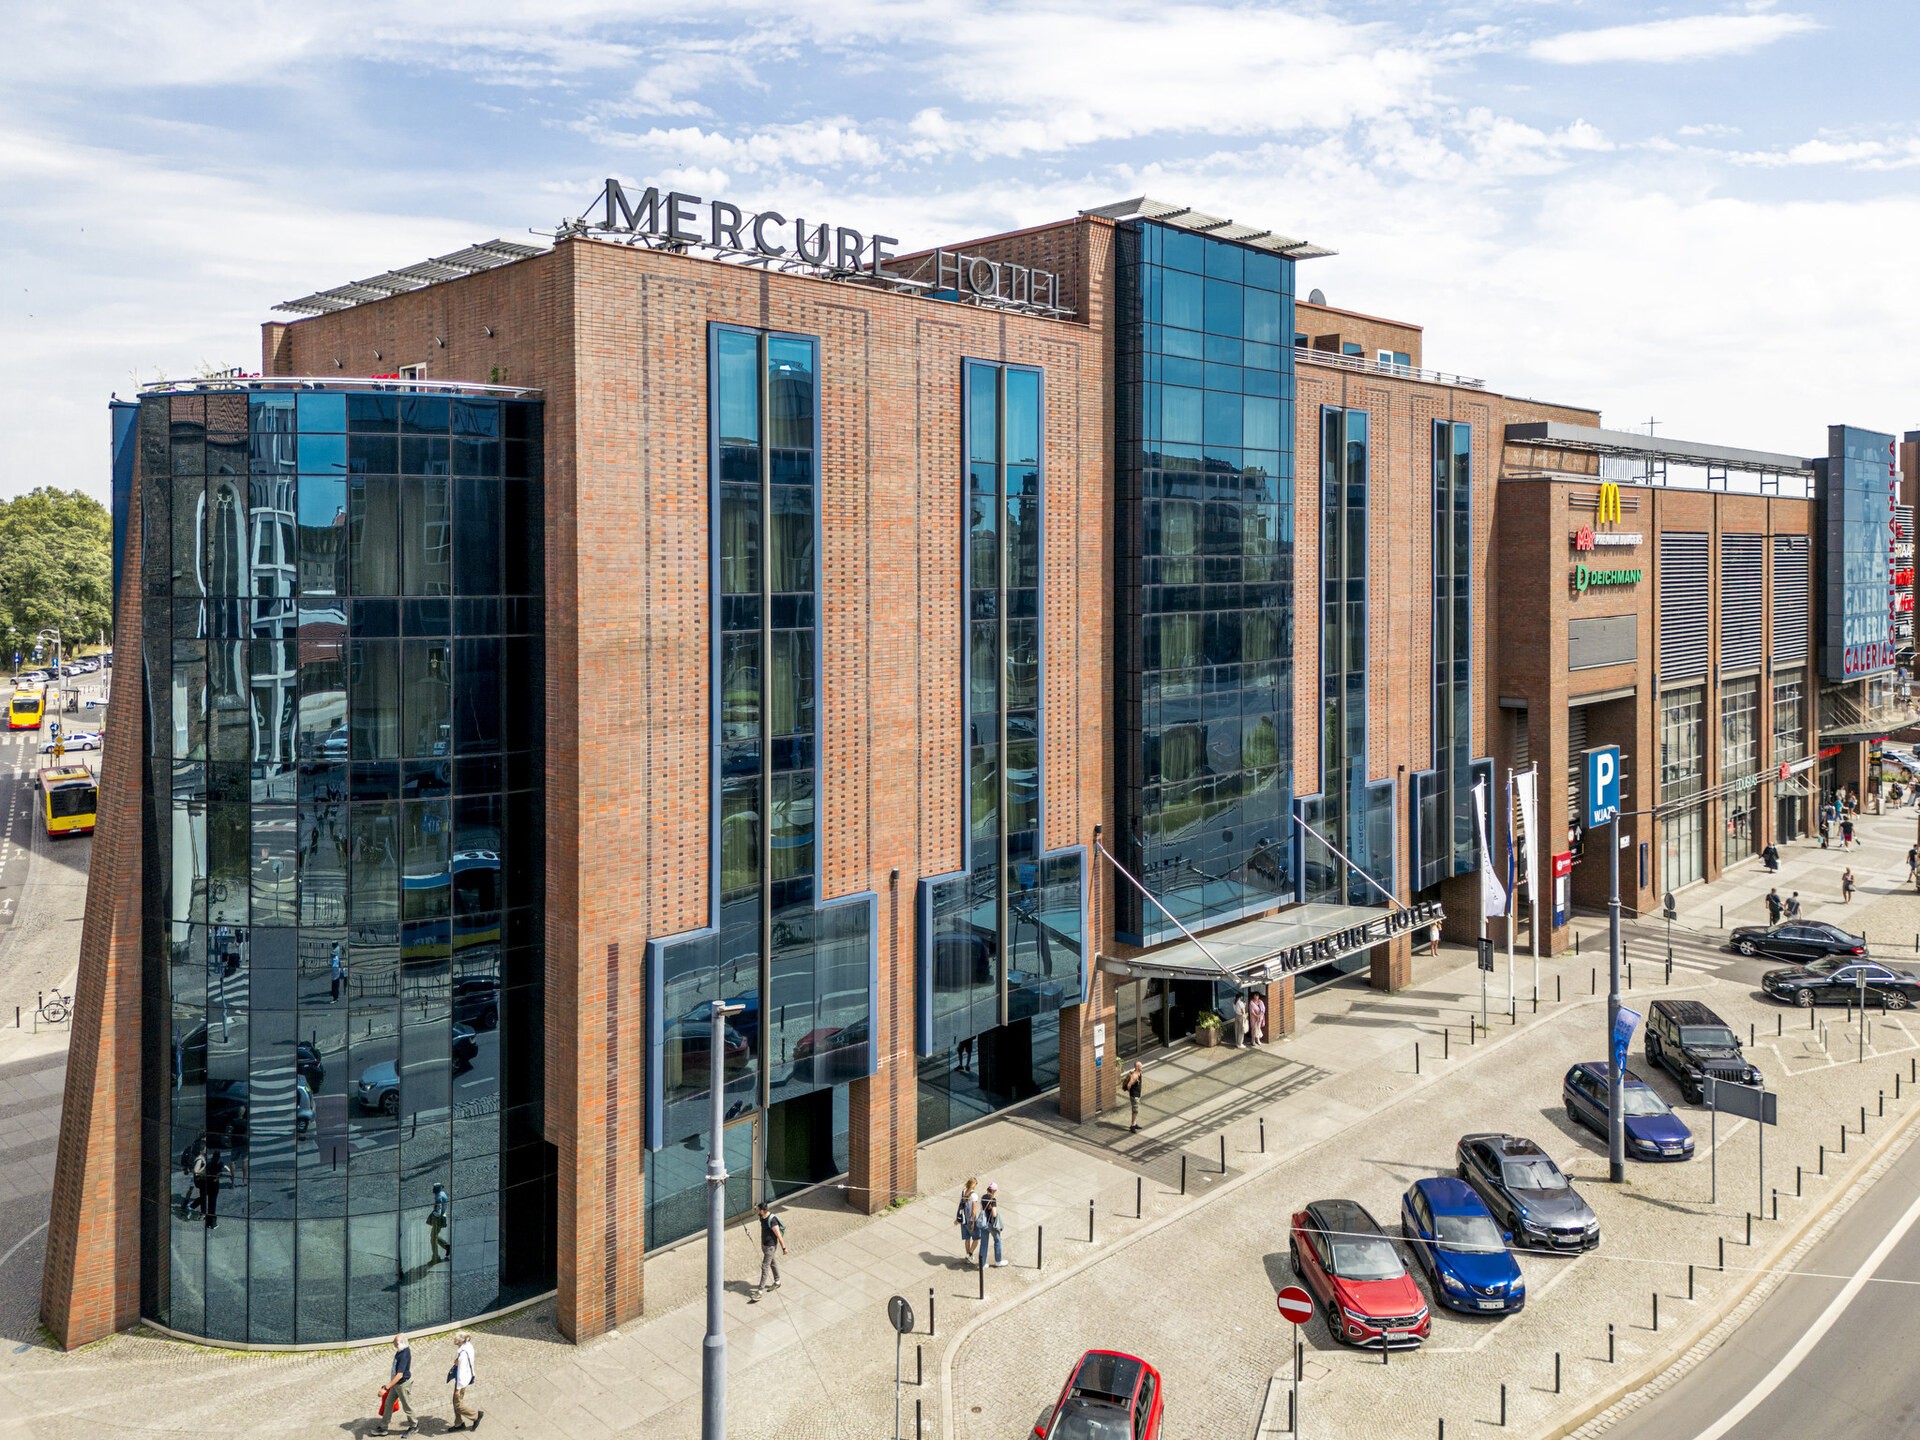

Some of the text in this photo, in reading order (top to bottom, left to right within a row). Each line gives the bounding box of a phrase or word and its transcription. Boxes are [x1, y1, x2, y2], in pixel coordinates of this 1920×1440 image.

[605, 178, 1059, 309] MERCURE HOTEL
[1591, 569, 1642, 585] DEICHMANN
[1844, 615, 1888, 647] GALERIA
[1844, 642, 1888, 675] GALERIA
[1597, 753, 1614, 806] P
